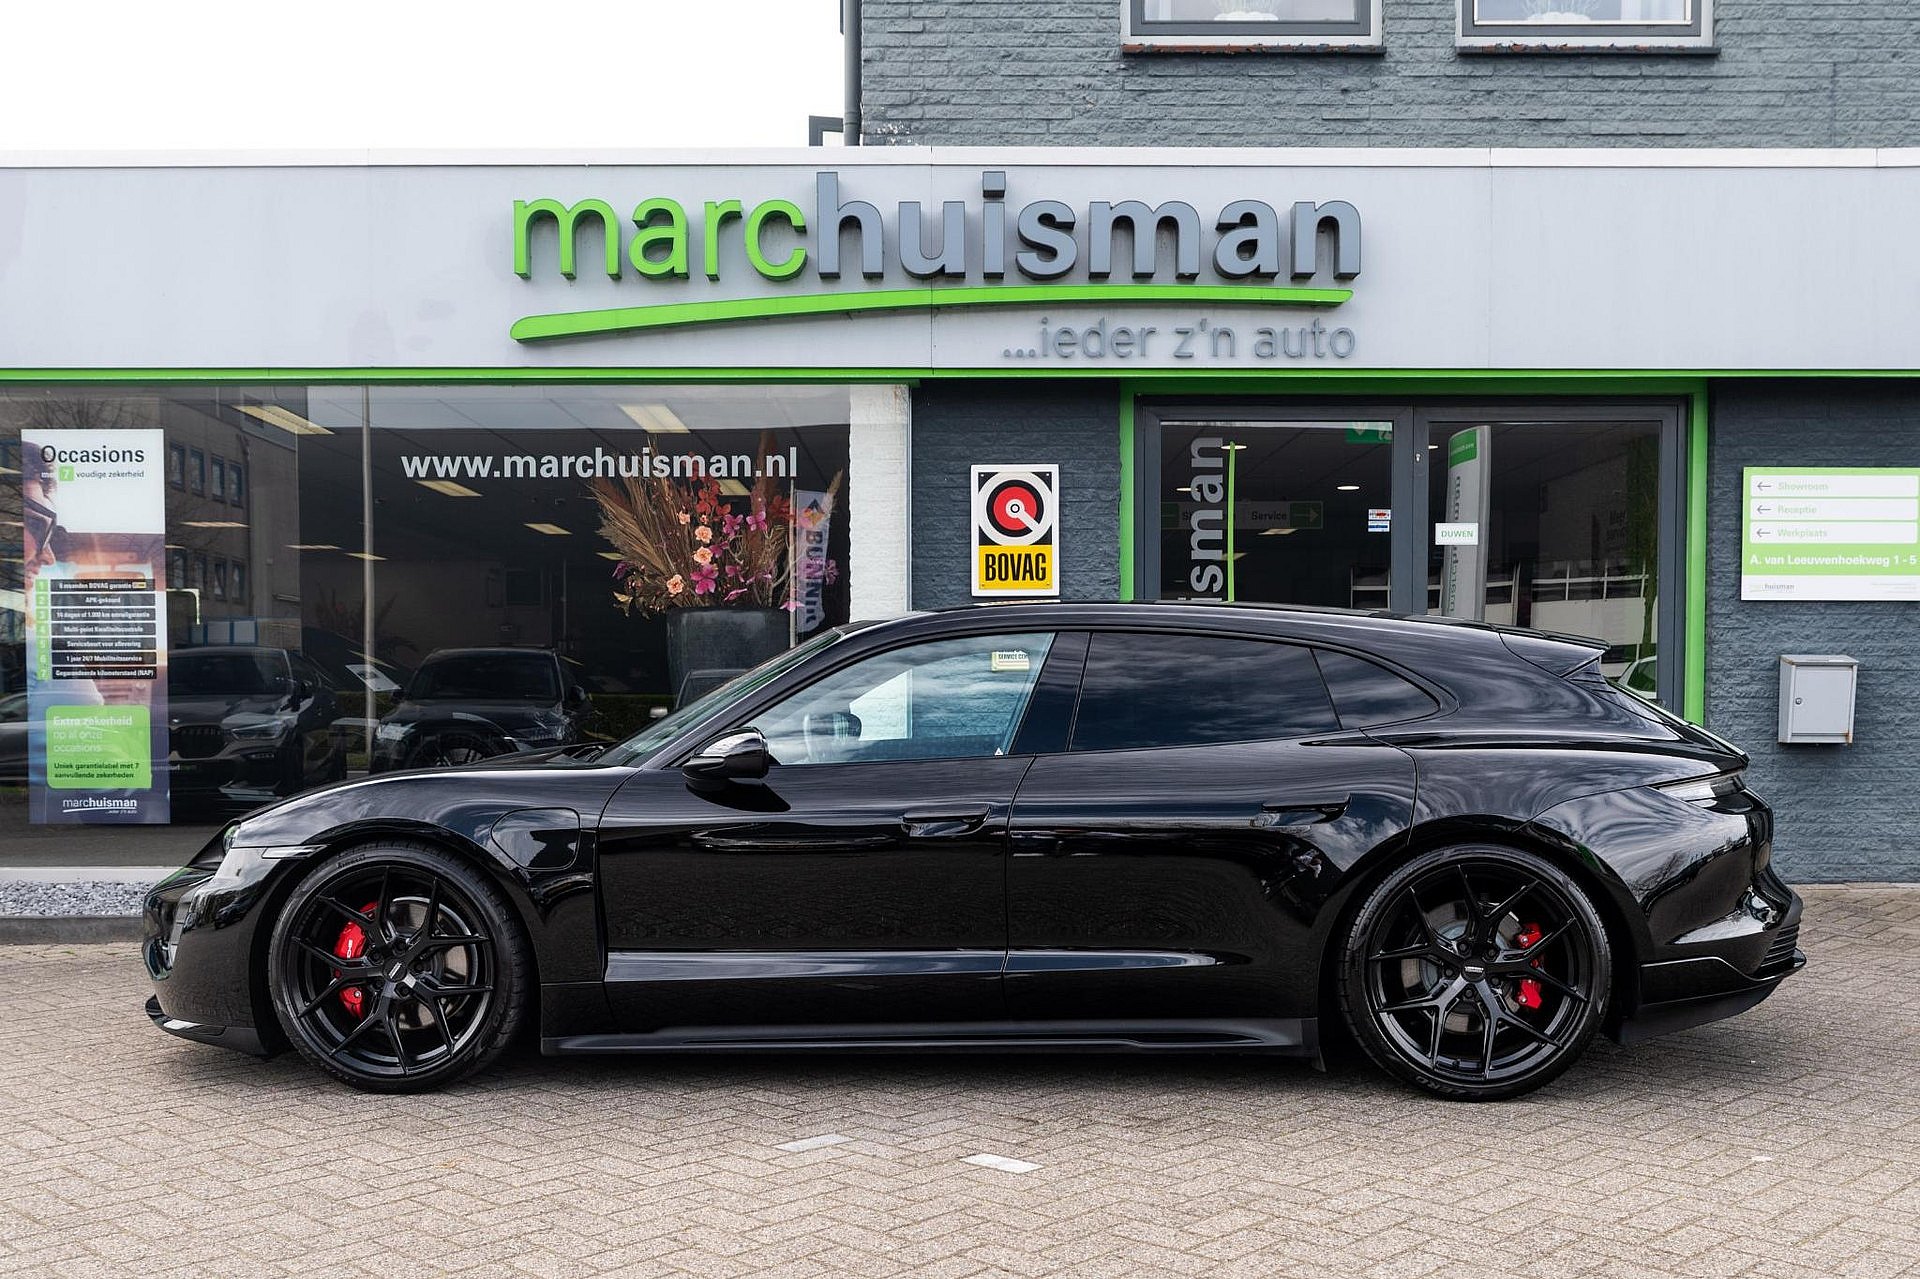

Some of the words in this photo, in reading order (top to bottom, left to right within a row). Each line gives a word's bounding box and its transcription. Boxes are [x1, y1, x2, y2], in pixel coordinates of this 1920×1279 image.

[513, 171, 1362, 282] marchuisman
[1173, 317, 1237, 359] z'n
[1254, 317, 1357, 359] auto
[41, 444, 145, 463] Occasions
[400, 446, 798, 479] www.marchuisman.nl
[76, 470, 107, 480] voudige
[108, 469, 145, 478] zekerheid
[1777, 481, 1829, 491] Showroom
[1251, 510, 1288, 521] Service
[1777, 505, 1818, 515] Receptie
[1178, 437, 1224, 601] sman
[1440, 529, 1474, 538] DUWEN
[1777, 528, 1828, 538] Werkplaats
[984, 552, 1047, 582] BOVAG
[1750, 554, 1761, 565] A.
[1764, 556, 1785, 565] van
[1788, 554, 1890, 568] Leeuwenhoekweg
[1909, 554, 1917, 565] 5
[62, 797, 138, 808] marchuisman
